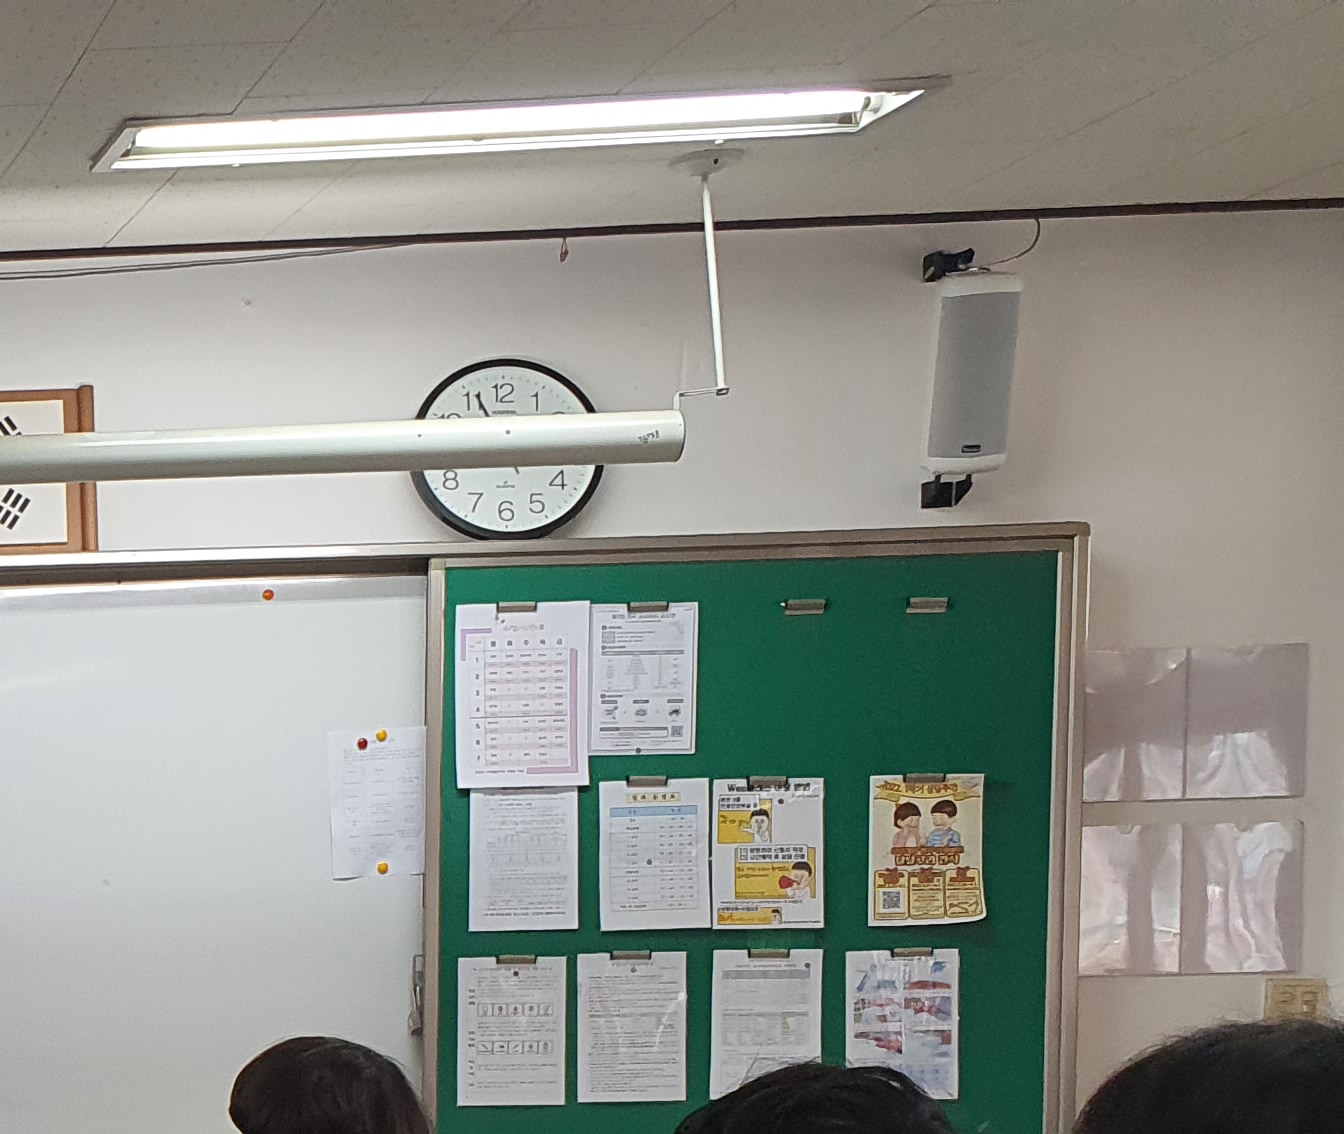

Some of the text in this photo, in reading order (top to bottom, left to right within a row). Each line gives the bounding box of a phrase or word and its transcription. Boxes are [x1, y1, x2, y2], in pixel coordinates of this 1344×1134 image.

[463, 391, 485, 411] 11
[491, 382, 515, 403] 12
[531, 391, 539, 412] 1
[442, 469, 459, 490] 8
[548, 469, 568, 491] 4
[467, 492, 484, 513] 7
[498, 500, 515, 521] 6
[528, 493, 545, 514] 5
